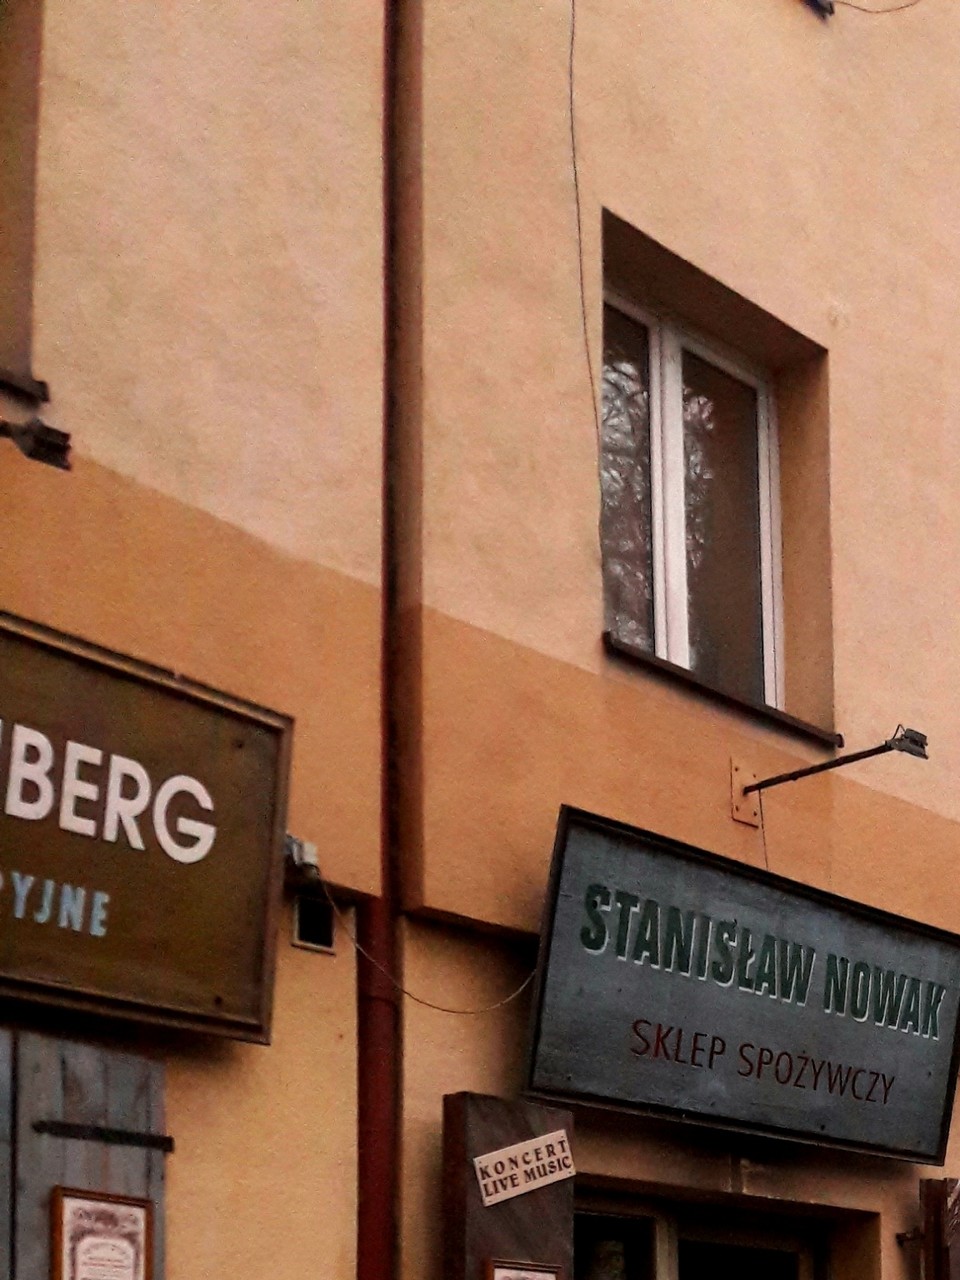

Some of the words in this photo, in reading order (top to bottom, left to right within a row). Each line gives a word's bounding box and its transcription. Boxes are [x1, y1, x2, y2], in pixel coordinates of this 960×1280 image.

[0, 718, 217, 864] BERG
[0, 868, 110, 938] YJNE
[580, 883, 816, 1007] STANISŁAW
[824, 953, 947, 1040] NOWAK
[630, 1018, 726, 1070] SKLEP
[738, 1043, 895, 1105] SPOŻYWCZY
[479, 1140, 566, 1181] KONCERT
[483, 1173, 519, 1198] LIVE
[524, 1156, 571, 1183] MUSIC
